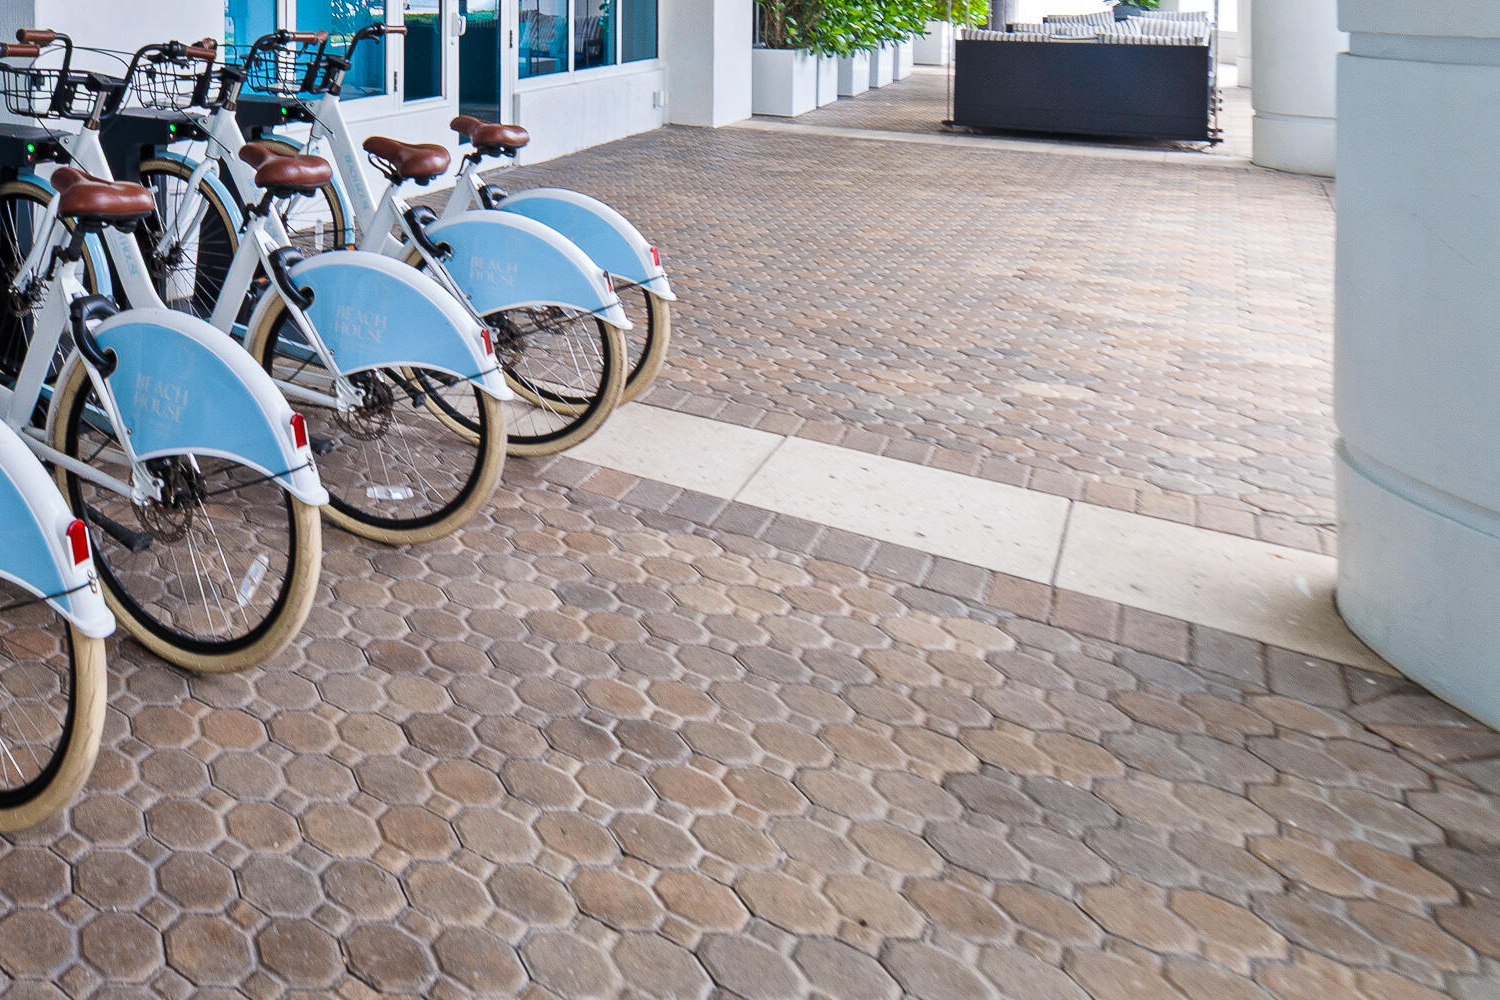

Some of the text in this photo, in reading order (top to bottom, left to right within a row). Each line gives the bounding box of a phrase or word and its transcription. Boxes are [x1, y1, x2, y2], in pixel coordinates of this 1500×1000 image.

[336, 304, 387, 329] BEACH
[133, 390, 184, 424] HOUSE
[135, 373, 188, 407] BEACH
